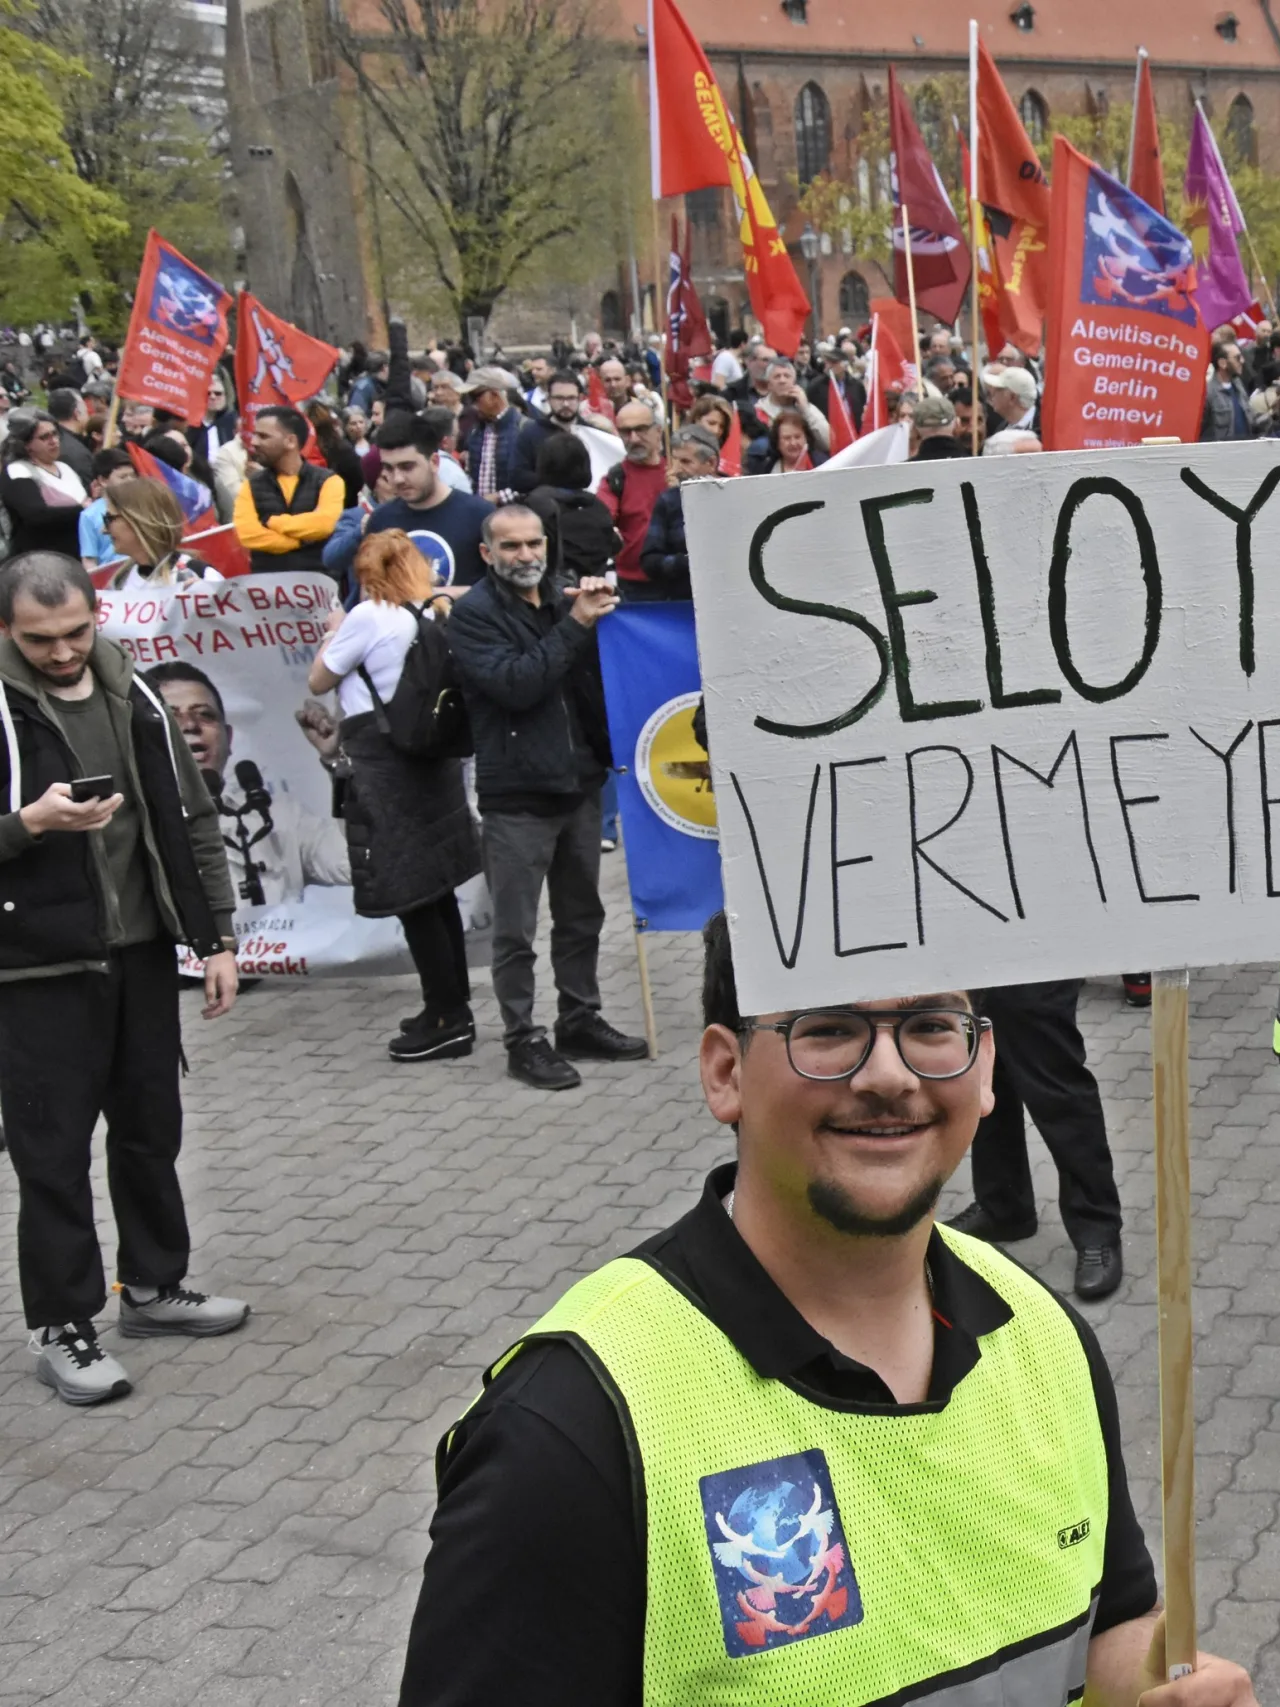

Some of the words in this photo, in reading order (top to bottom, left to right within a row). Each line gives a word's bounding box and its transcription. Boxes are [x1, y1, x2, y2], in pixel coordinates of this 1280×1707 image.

[1070, 319, 1199, 360] Alevitische
[1073, 347, 1191, 382] Gemeinde
[1093, 376, 1158, 400] Berlin
[1081, 402, 1163, 426] Cemevi
[175, 590, 246, 620] TEK
[183, 629, 235, 655] YA
